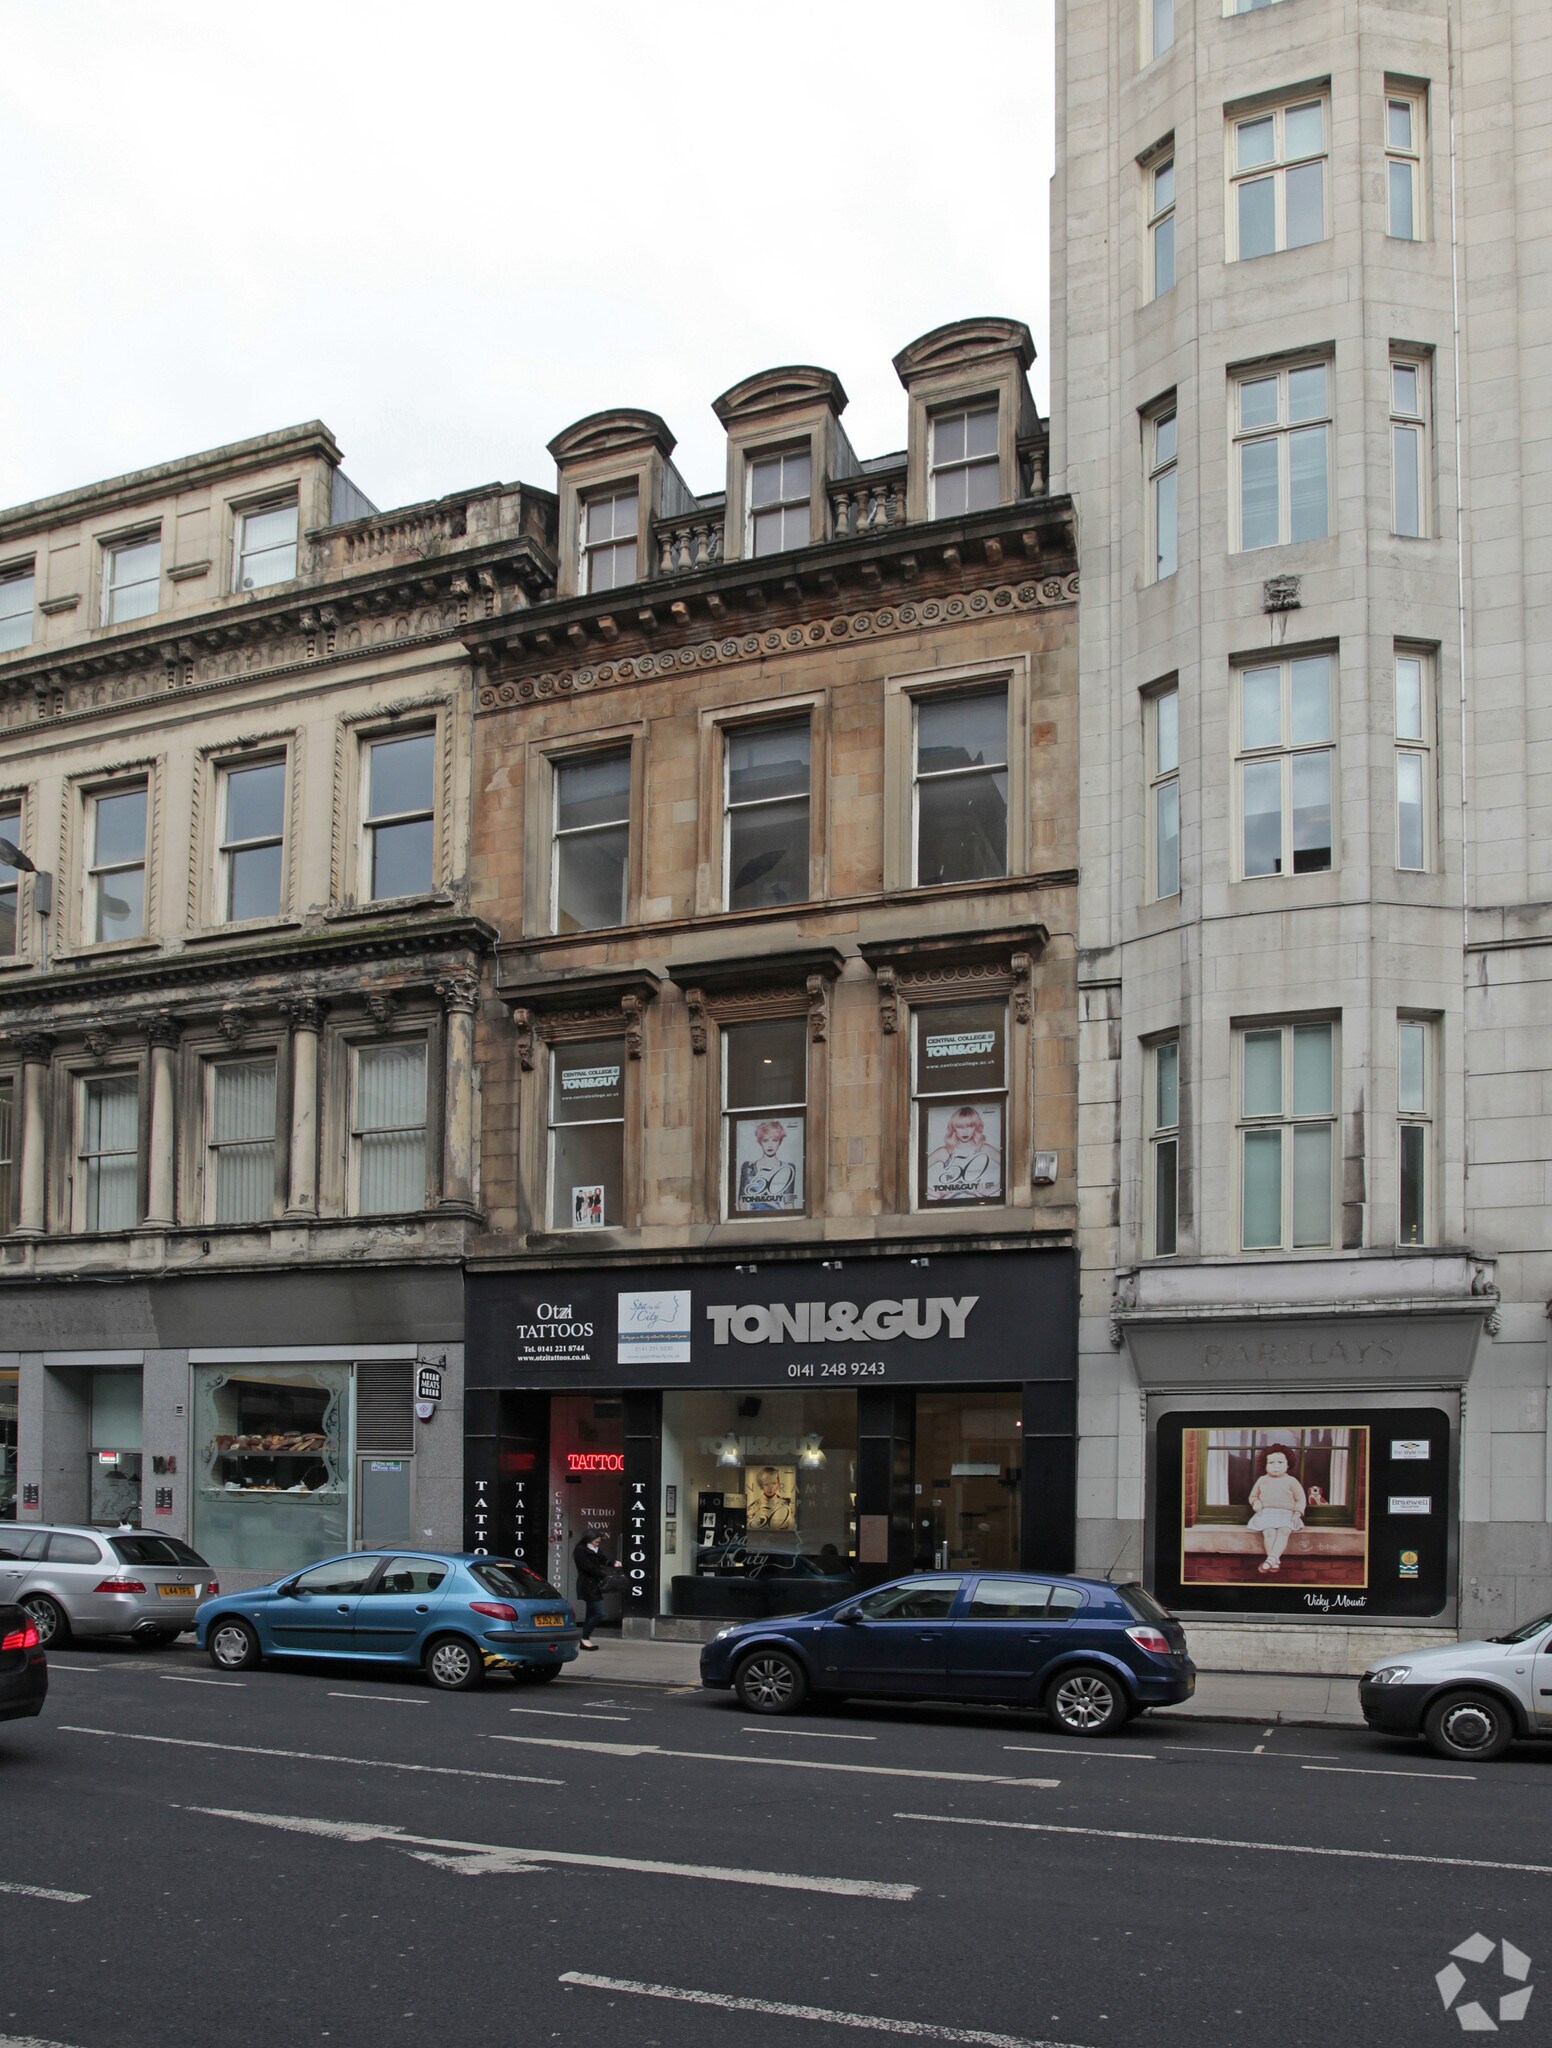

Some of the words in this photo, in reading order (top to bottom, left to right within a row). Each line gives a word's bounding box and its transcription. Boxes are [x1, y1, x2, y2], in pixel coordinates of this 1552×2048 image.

[926, 1042, 995, 1057] TONI&GUY
[561, 1075, 620, 1090] TONI&GUY
[933, 1182, 980, 1192] TONI&GUY
[741, 1194, 784, 1203] TONI&GUY
[536, 1302, 573, 1320] Otzi
[706, 1296, 980, 1345] TONI&GUY
[516, 1322, 594, 1339] TATTOOS
[537, 1345, 553, 1353] 0141
[517, 1353, 591, 1362] www.otzitattoos.co.uk
[787, 1364, 815, 1377] 0141
[820, 1362, 847, 1376] 248
[850, 1362, 886, 1376] 9243
[420, 1381, 441, 1389] MEATS
[554, 1490, 563, 1536] CUSTOM
[580, 1508, 616, 1517] STUDIO
[587, 1521, 610, 1530] NOW
[629, 1483, 647, 1597] TATTOOS
[553, 1544, 562, 1593] TATTOO
[1331, 1594, 1368, 1608] Mount
